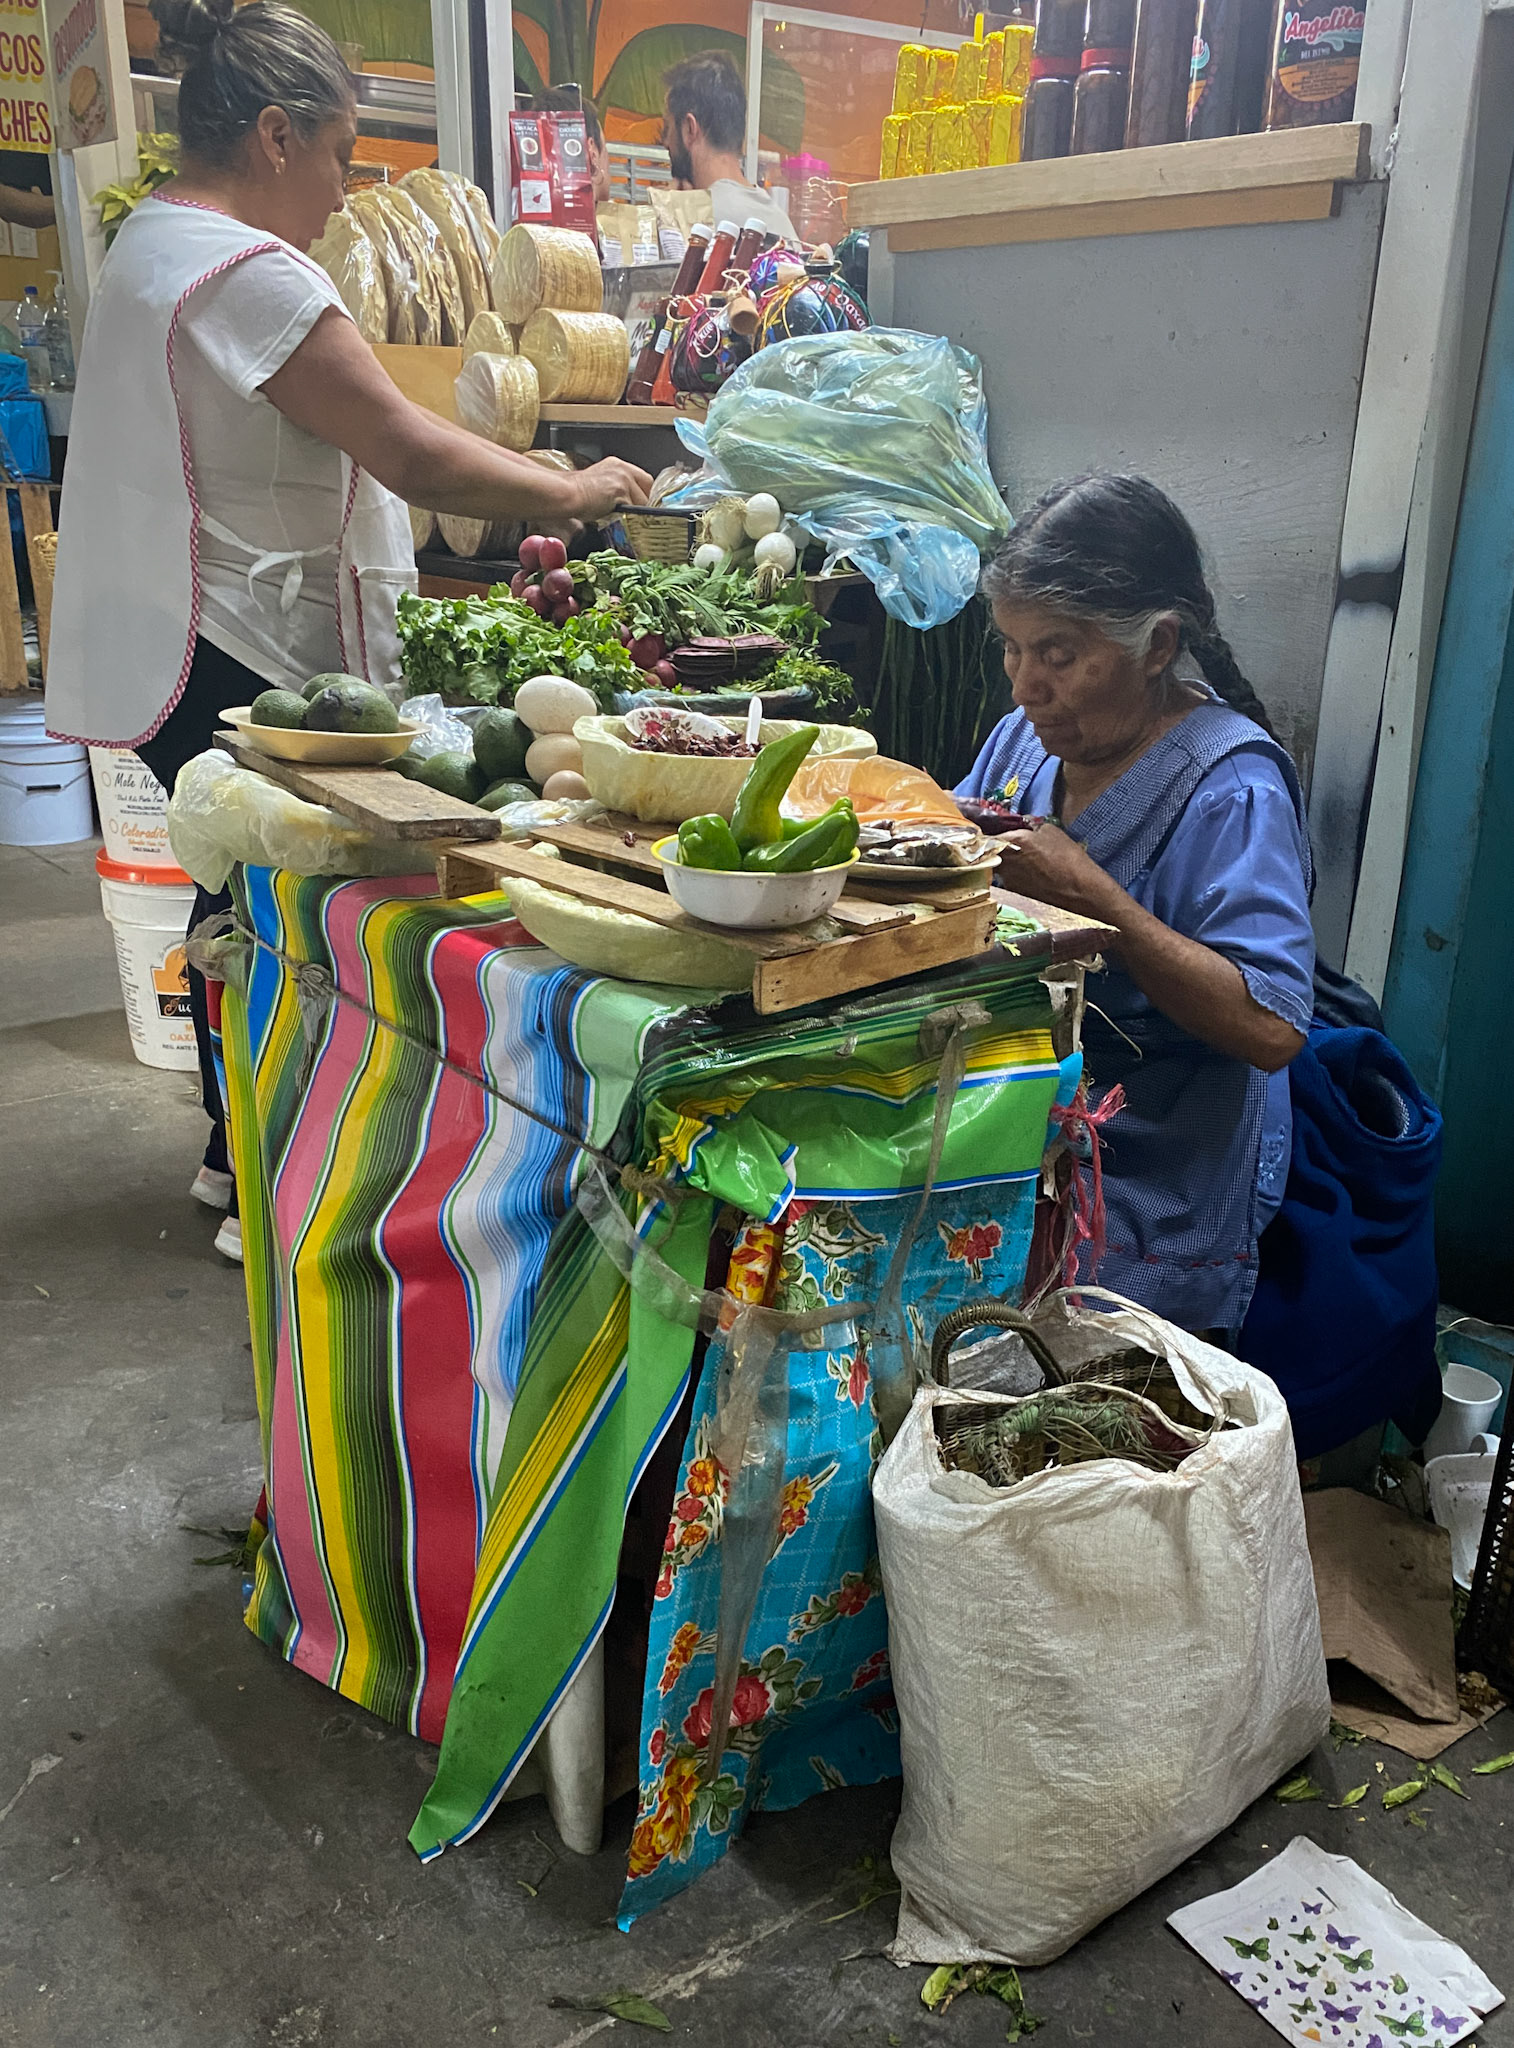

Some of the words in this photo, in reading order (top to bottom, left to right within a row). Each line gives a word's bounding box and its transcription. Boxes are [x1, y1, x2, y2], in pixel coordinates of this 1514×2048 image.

[1284, 6, 1364, 45] Angelita
[0, 98, 52, 145] CHES
[114, 772, 136, 788] Mole
[140, 774, 164, 794] Neg
